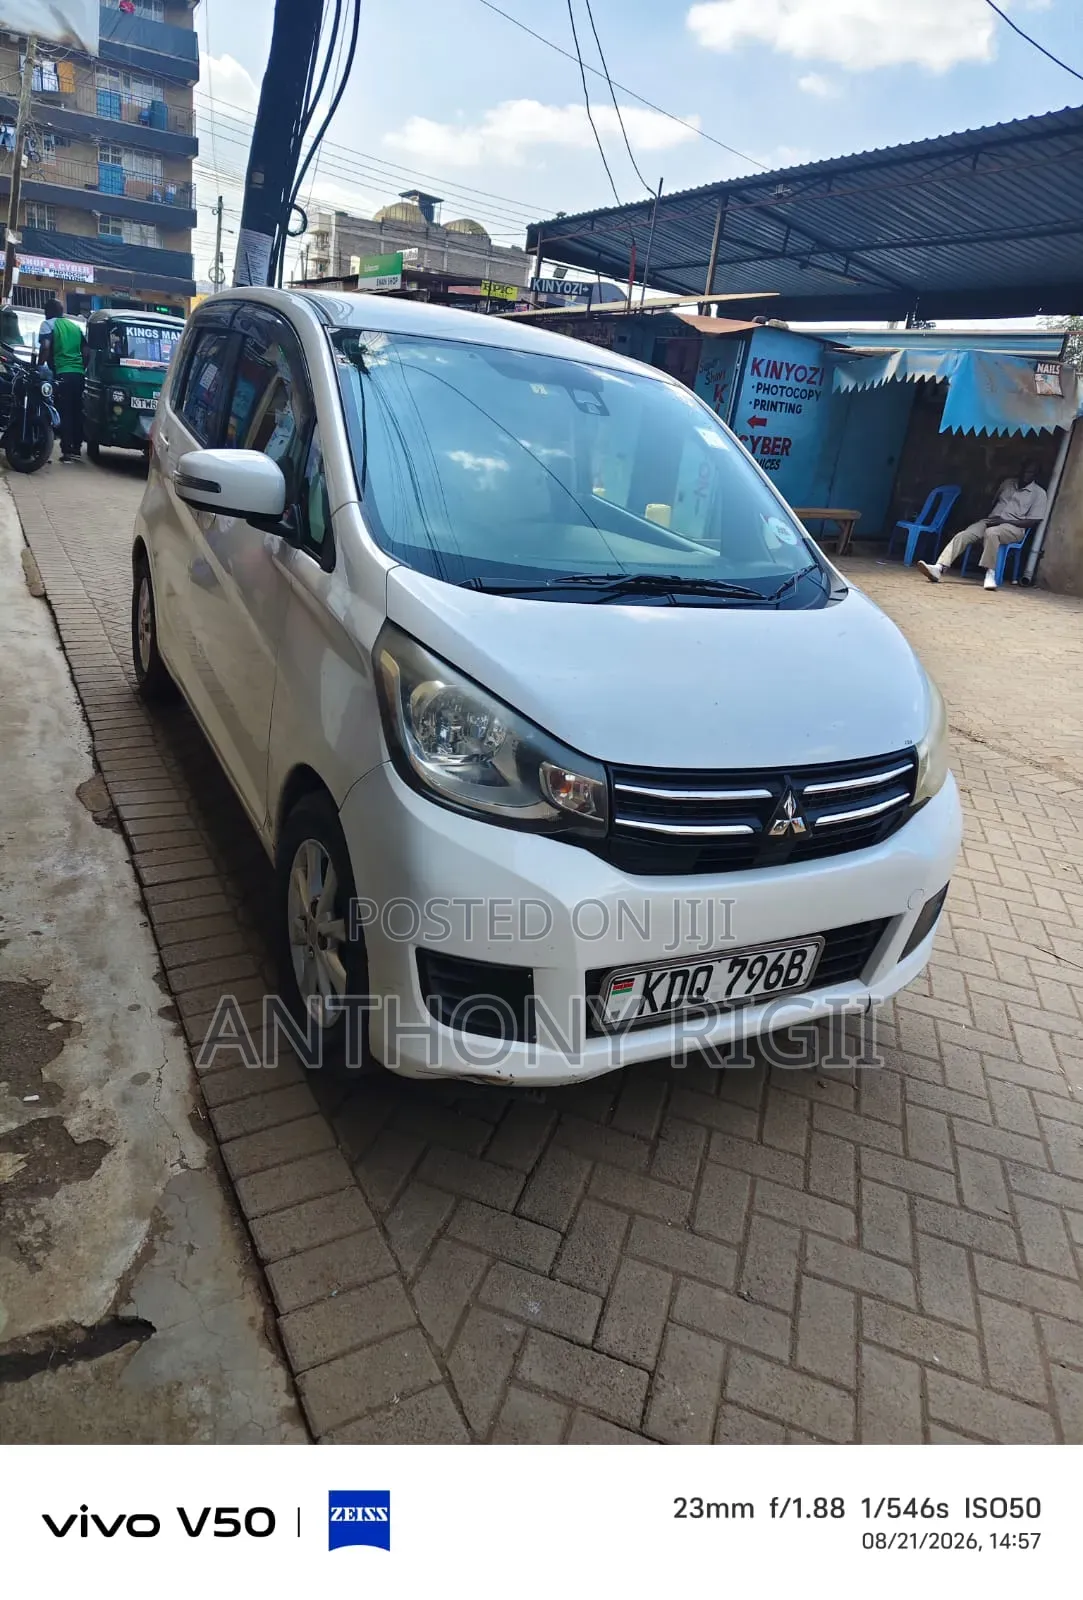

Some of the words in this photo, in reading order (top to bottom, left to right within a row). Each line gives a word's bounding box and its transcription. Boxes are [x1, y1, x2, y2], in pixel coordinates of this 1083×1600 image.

[532, 278, 582, 295] KINYOZI
[126, 327, 159, 339] KINGS
[750, 357, 825, 386] KINYOZI
[1037, 363, 1061, 375] NAILS
[755, 382, 822, 401] PHOTOCOPY
[753, 399, 802, 415] PRINTING
[638, 965, 714, 1015] KDQ
[725, 949, 808, 996] 796B
